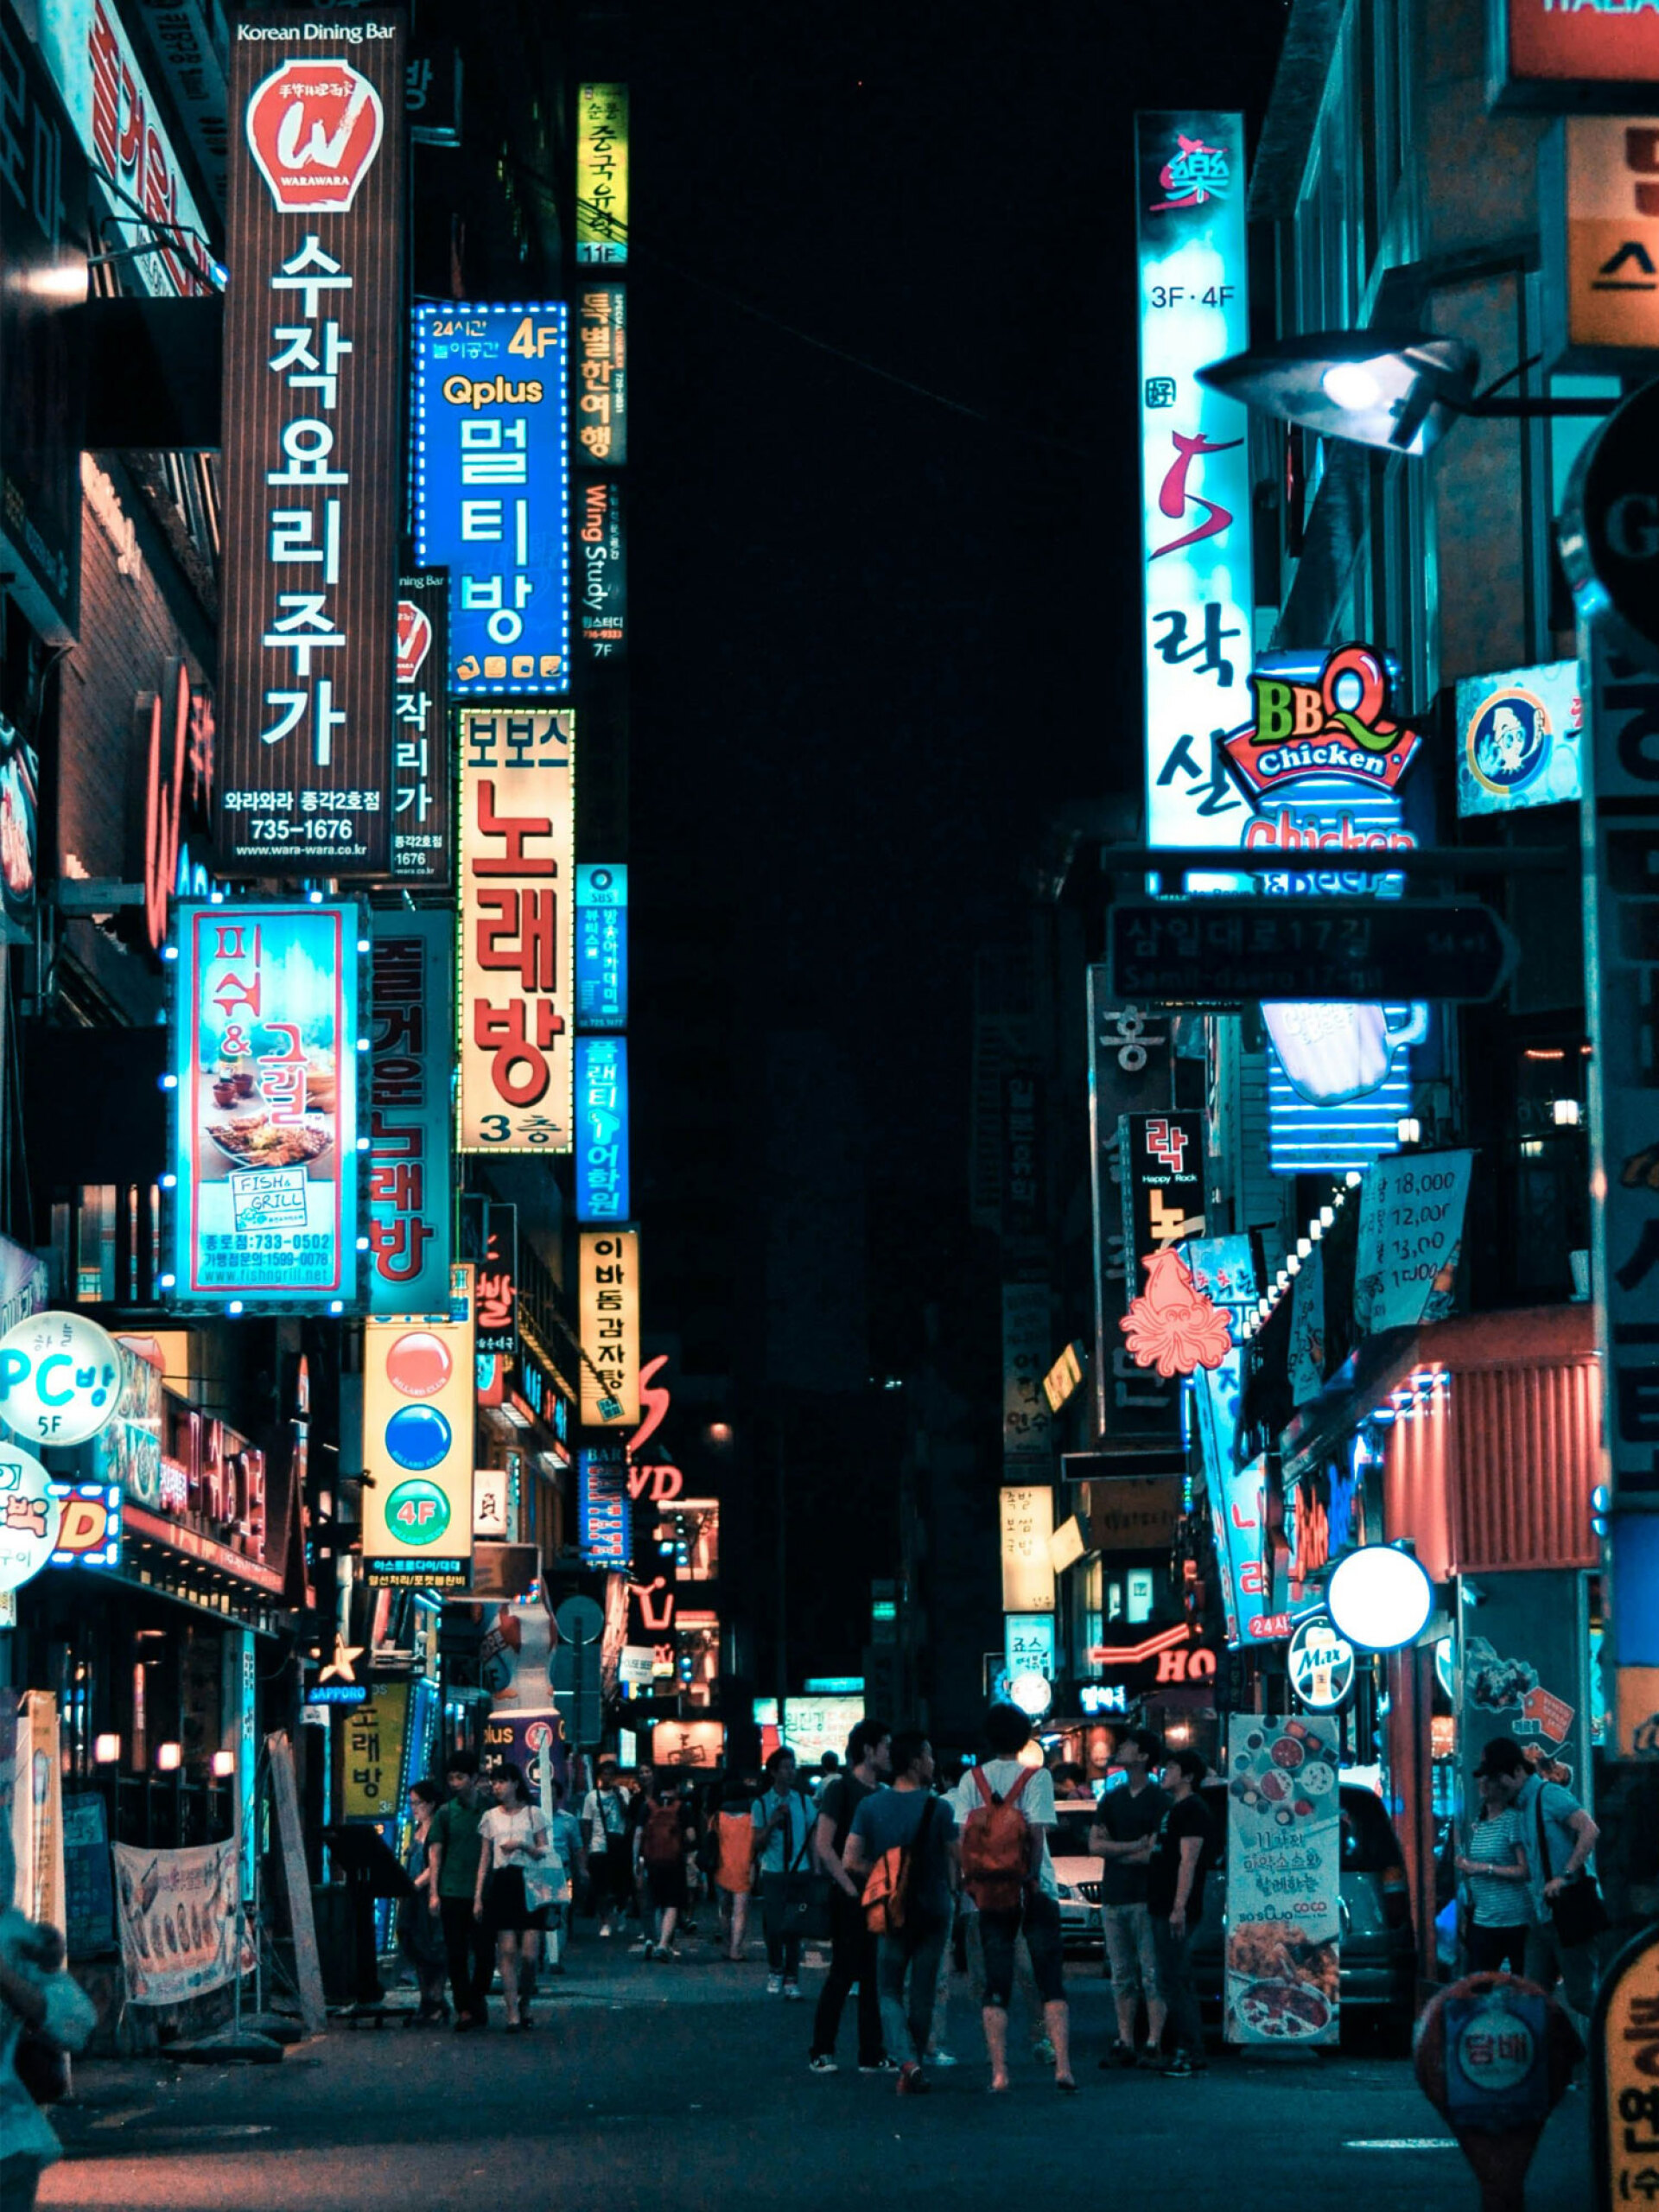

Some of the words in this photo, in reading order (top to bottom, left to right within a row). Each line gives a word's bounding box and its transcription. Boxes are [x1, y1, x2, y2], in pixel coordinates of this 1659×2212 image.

[237, 24, 300, 41] Korean
[303, 24, 363, 43] Dining
[366, 23, 396, 39] Bar
[280, 175, 350, 186] WARAWARA
[582, 245, 617, 262] 11F
[433, 321, 487, 337] 24시간
[507, 317, 559, 359] 4F
[443, 375, 543, 410] Qplus
[262, 236, 353, 766] 수작요리주가
[580, 484, 607, 543] Wing
[461, 418, 532, 645] 멀티방
[426, 575, 445, 586] Bar
[582, 545, 609, 611] Study
[593, 644, 613, 657] 7F
[1249, 646, 1400, 753] BBQ
[467, 716, 569, 768] 보보스
[1257, 744, 1387, 779] Chicken
[225, 791, 294, 810] 와라와라
[301, 791, 380, 811] 종각2호점
[251, 820, 353, 840] 735-1676
[236, 844, 367, 856] www.wara-wara.co.kr
[591, 893, 614, 904] SBS
[472, 779, 565, 1109] 노래방
[258, 1022, 308, 1125] 그릴
[479, 1114, 562, 1142] 3층
[1146, 1118, 1188, 1173] 락
[239, 1174, 283, 1192] FISH
[1142, 1175, 1172, 1185] Happy
[1174, 1173, 1198, 1184] Rock
[251, 1193, 302, 1210] GRILL
[38, 1415, 62, 1436] 5F
[588, 1448, 621, 1462] BAR
[397, 1501, 436, 1525] 4F
[59, 1501, 107, 1548] D
[1296, 1648, 1341, 1678] Max
[308, 1687, 366, 1701] SAPPORO
